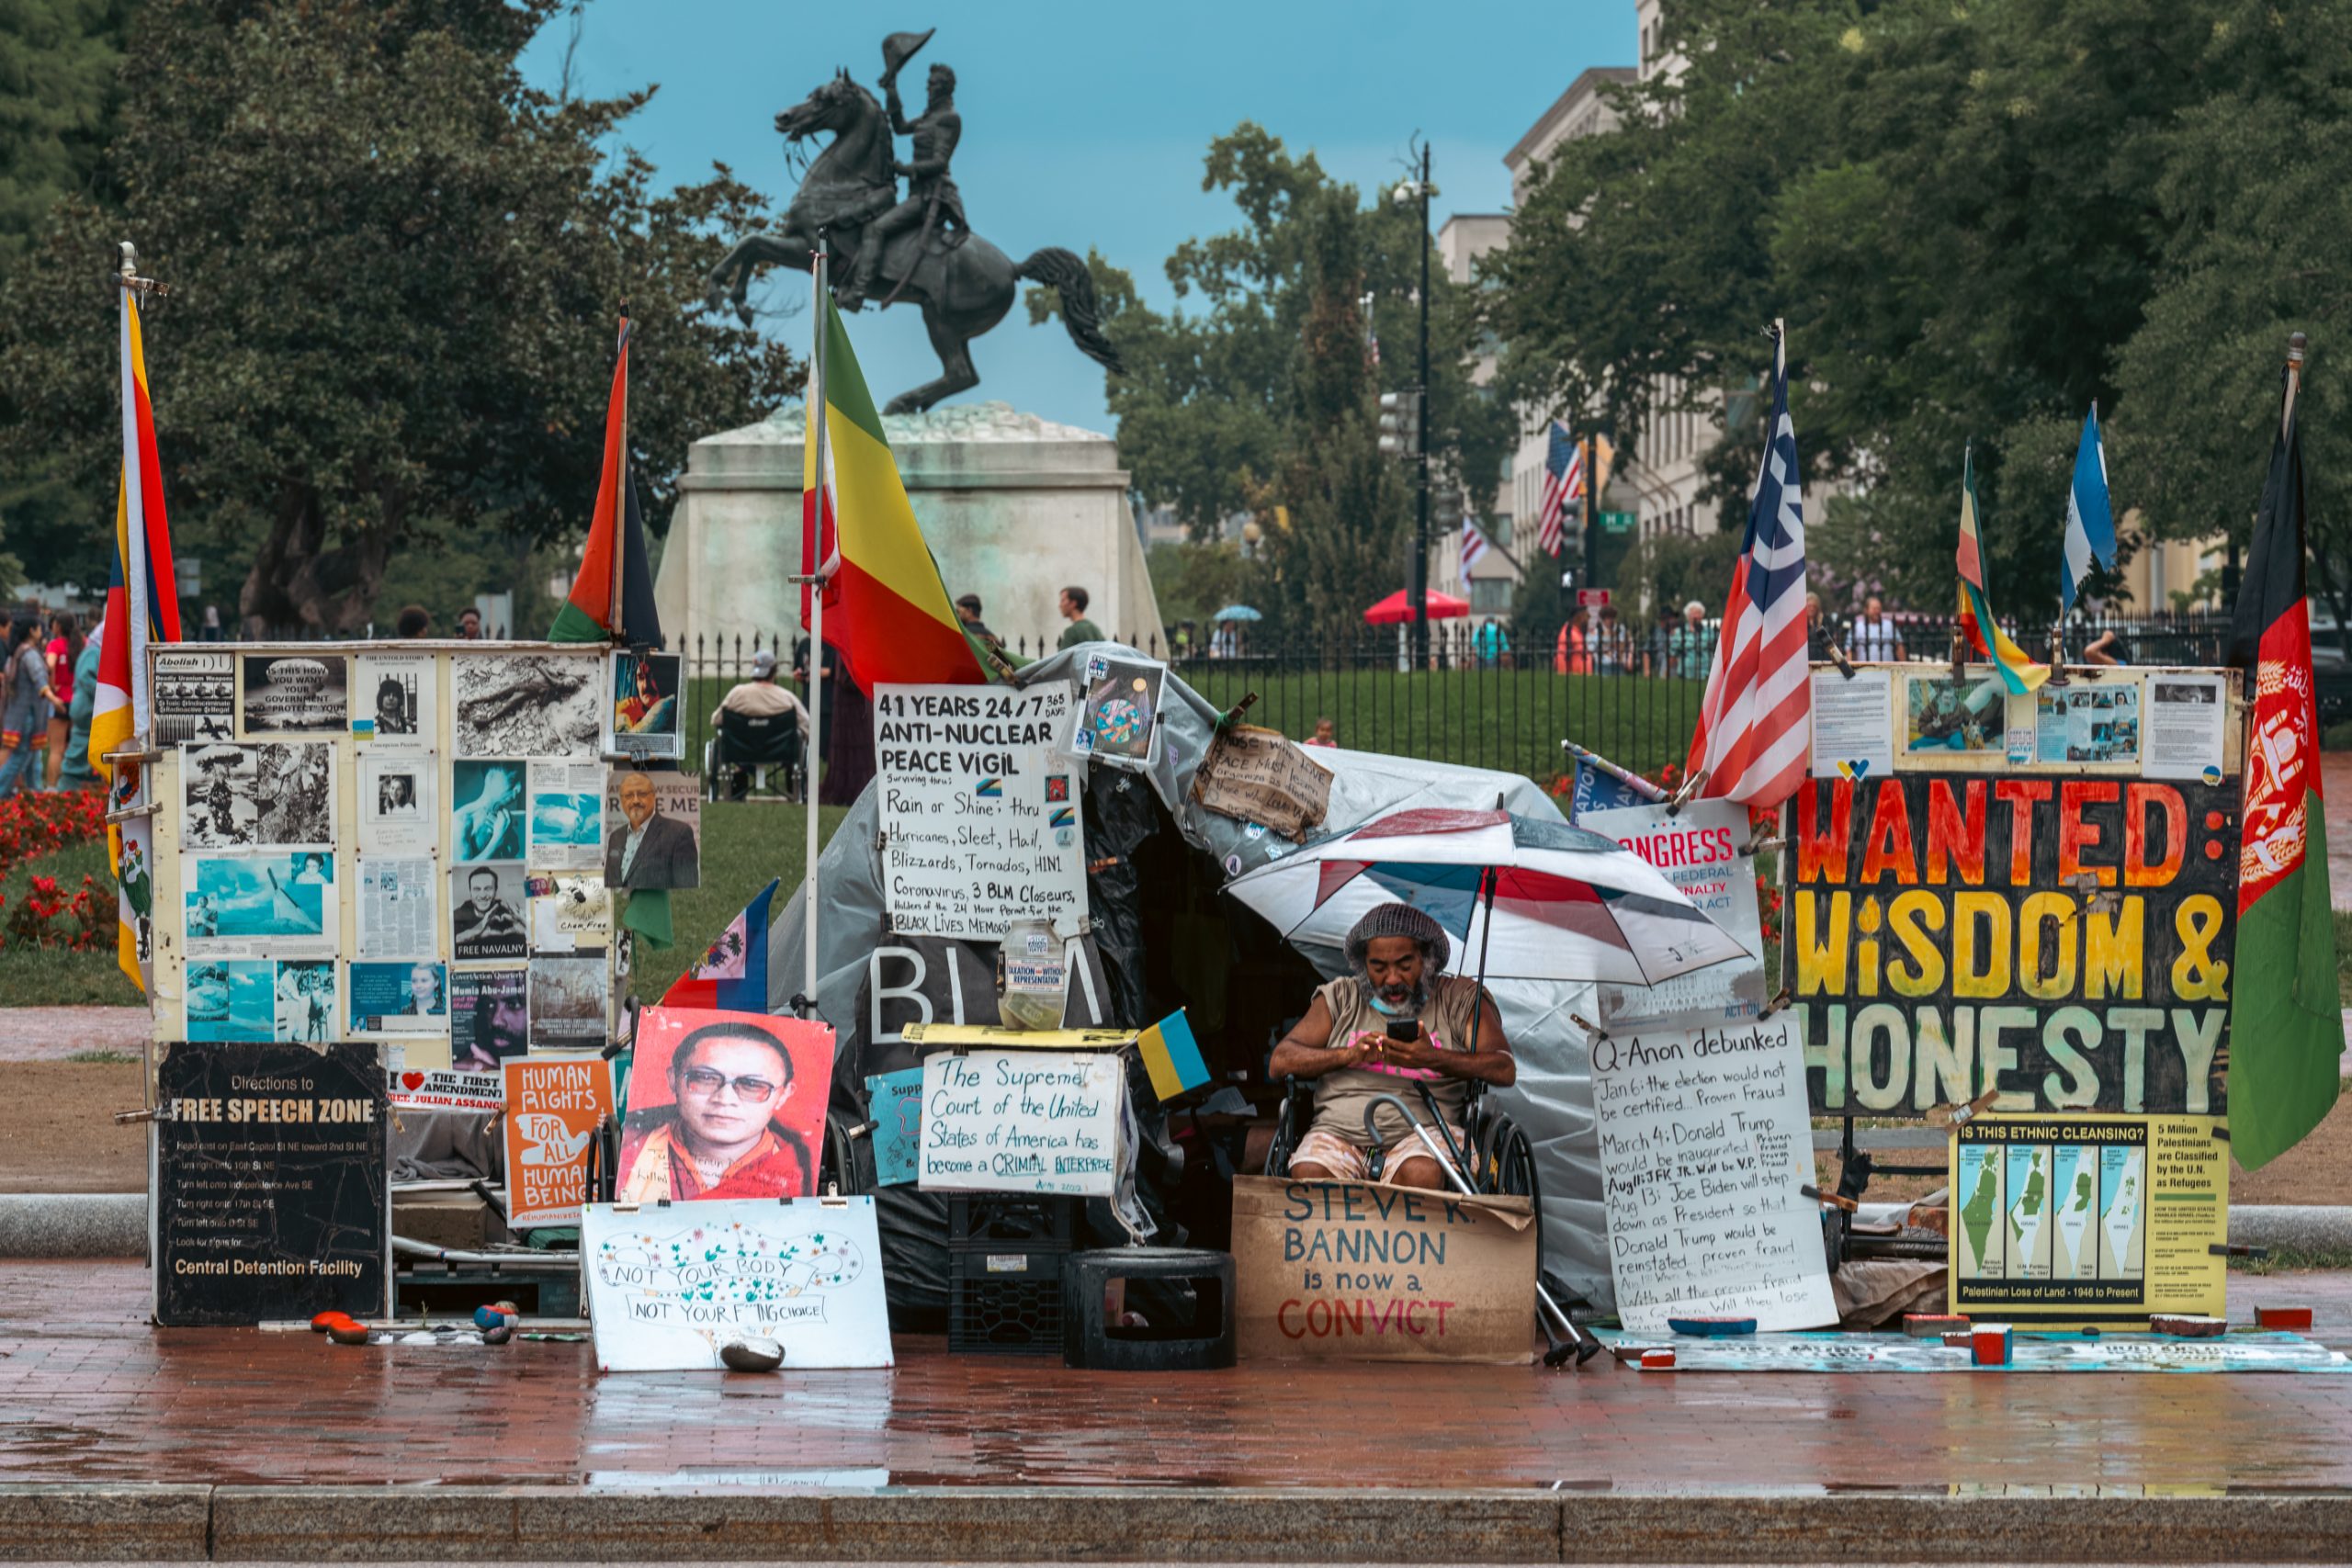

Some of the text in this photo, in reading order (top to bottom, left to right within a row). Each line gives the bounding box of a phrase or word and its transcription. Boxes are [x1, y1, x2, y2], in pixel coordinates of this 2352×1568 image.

[159, 658, 198, 666] Abolish
[878, 694, 905, 717] 41
[910, 696, 980, 717] YEARS
[1046, 694, 1065, 706] 365
[879, 721, 1053, 745] ANTI-NUCLEAR
[881, 750, 952, 773] PEACE
[887, 773, 926, 786] Surviving
[670, 797, 697, 812] ME
[888, 788, 923, 815] Rain
[931, 800, 944, 813] or
[1010, 797, 1040, 817] thru
[889, 821, 1042, 851] Hurricanes, Sleet, Hail,
[891, 850, 962, 873] Blizzards,
[965, 853, 1030, 875] Tornados,
[1673, 867, 1734, 882] FEDERAL
[894, 875, 969, 902] Coronavirus,
[972, 883, 981, 898] 3
[988, 885, 1014, 900] BLM
[1707, 897, 1731, 909] ACT
[895, 914, 931, 931] BLACK
[458, 943, 525, 955] FREE NAVALNY
[2171, 893, 2230, 1002] &
[493, 971, 524, 980] Quarterly
[1013, 976, 1059, 985] REPRESENTATION
[452, 985, 525, 996] Mumia Abu-Jamal
[1593, 1023, 1788, 1072] Q-Anon debunked
[1790, 1002, 2228, 1113] HONESTY
[232, 1075, 313, 1091] Directions to
[390, 1072, 399, 1089] I
[432, 1073, 500, 1087] THE FIRST
[522, 1065, 591, 1089] HUMAN
[938, 1055, 1083, 1094] The Supreme
[1646, 1075, 1670, 1093] the
[1674, 1069, 1717, 1089] election
[1724, 1066, 1759, 1083] would
[1764, 1060, 1786, 1078] not
[171, 1098, 375, 1123] FREE SPEECH ZONE
[413, 1095, 452, 1105] JULIAN
[455, 1098, 502, 1109] ASSANG
[522, 1089, 597, 1112] RIGHTS
[930, 1089, 1099, 1120] Court of the United
[530, 1115, 565, 1143] FOR
[929, 1120, 1099, 1150] States of America has
[1961, 1126, 2145, 1141] IS THIS ETHNIC CLEANSING?
[2158, 1124, 2198, 1134] 5 Million
[544, 1142, 576, 1164] ALL
[2158, 1138, 2211, 1147] Palestinians
[927, 1153, 973, 1175] become
[978, 1161, 988, 1173] a
[1055, 1154, 1114, 1174] ENTERPRISE
[2157, 1151, 2218, 1161] are Classified
[2156, 1165, 2205, 1175] by the U.N.
[177, 1179, 194, 1190] Turn
[196, 1179, 208, 1190] left
[209, 1180, 227, 1190] onto
[285, 1181, 300, 1190] Ave
[301, 1181, 313, 1190] SE
[2156, 1179, 2211, 1190] as Refugees
[1283, 1182, 1427, 1223] STEVE
[1283, 1227, 1446, 1265] BANNON
[175, 1259, 363, 1279] Central Detention Facility
[615, 1258, 793, 1285] NOT YOUR BODY
[1304, 1269, 1423, 1292] is now a
[1962, 1286, 2007, 1298] Palestinian
[2010, 1287, 2031, 1297] Loss
[2034, 1287, 2042, 1298] of
[2045, 1287, 2065, 1298] Land
[2074, 1287, 2093, 1298] 1946
[2096, 1288, 2104, 1298] to
[2107, 1288, 2139, 1298] Present
[636, 1302, 673, 1319] NOT
[681, 1303, 731, 1323] YOUR
[779, 1305, 820, 1320] CHOICE
[1277, 1298, 1455, 1339] CONVICT
